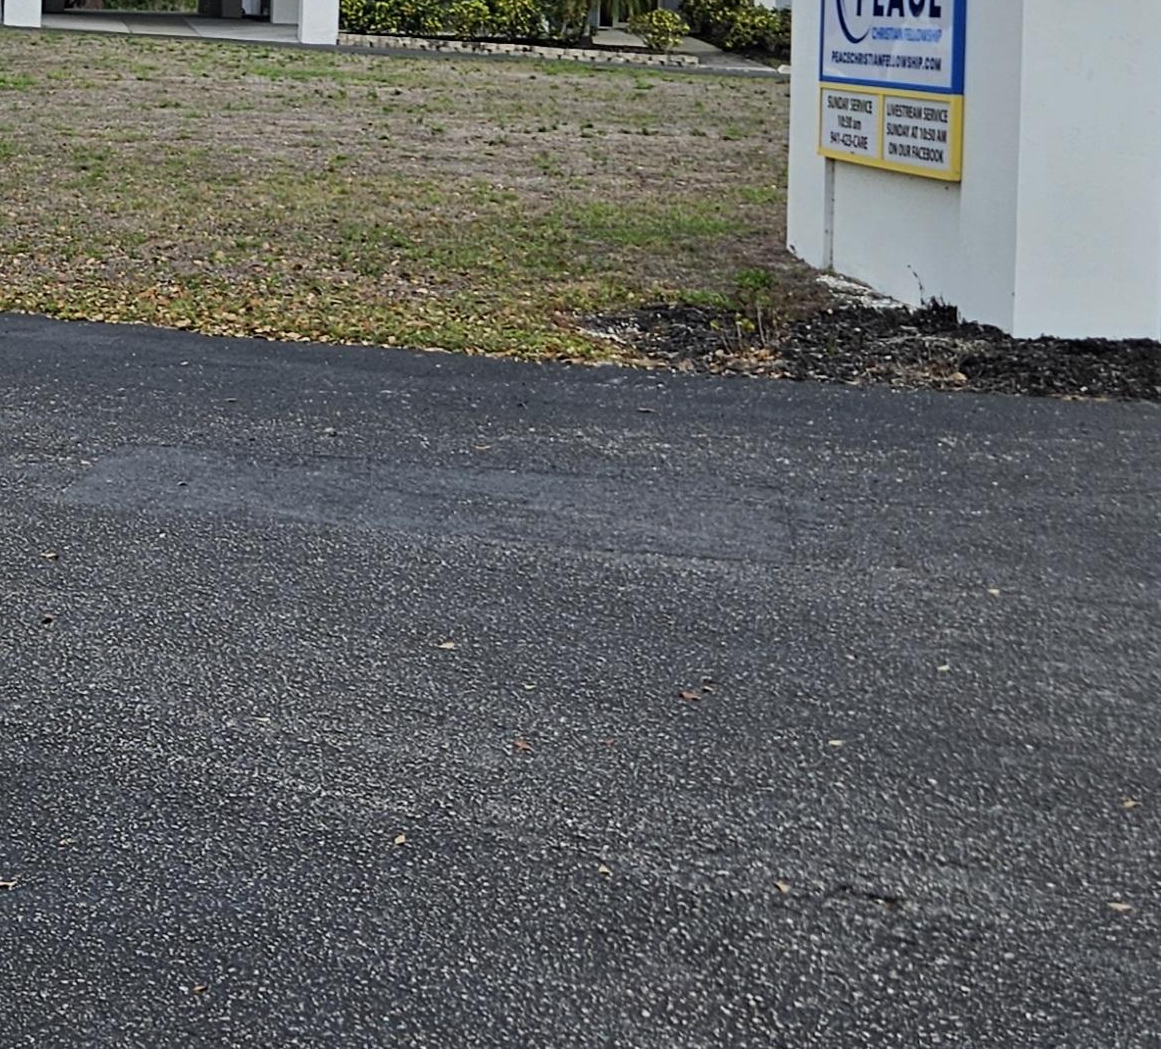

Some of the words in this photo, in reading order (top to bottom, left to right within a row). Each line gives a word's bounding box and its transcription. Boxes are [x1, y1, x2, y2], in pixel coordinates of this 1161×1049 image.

[827, 95, 849, 110] SUNDAY
[850, 98, 872, 114] SERVICE
[887, 103, 922, 119] LIVESTREAM
[923, 107, 948, 123] SERVICE
[887, 122, 910, 138] SUNDAY
[911, 125, 919, 139] AT
[889, 142, 898, 155] ON
[899, 143, 911, 157] OUR
[912, 145, 944, 163] FACEBOOK
